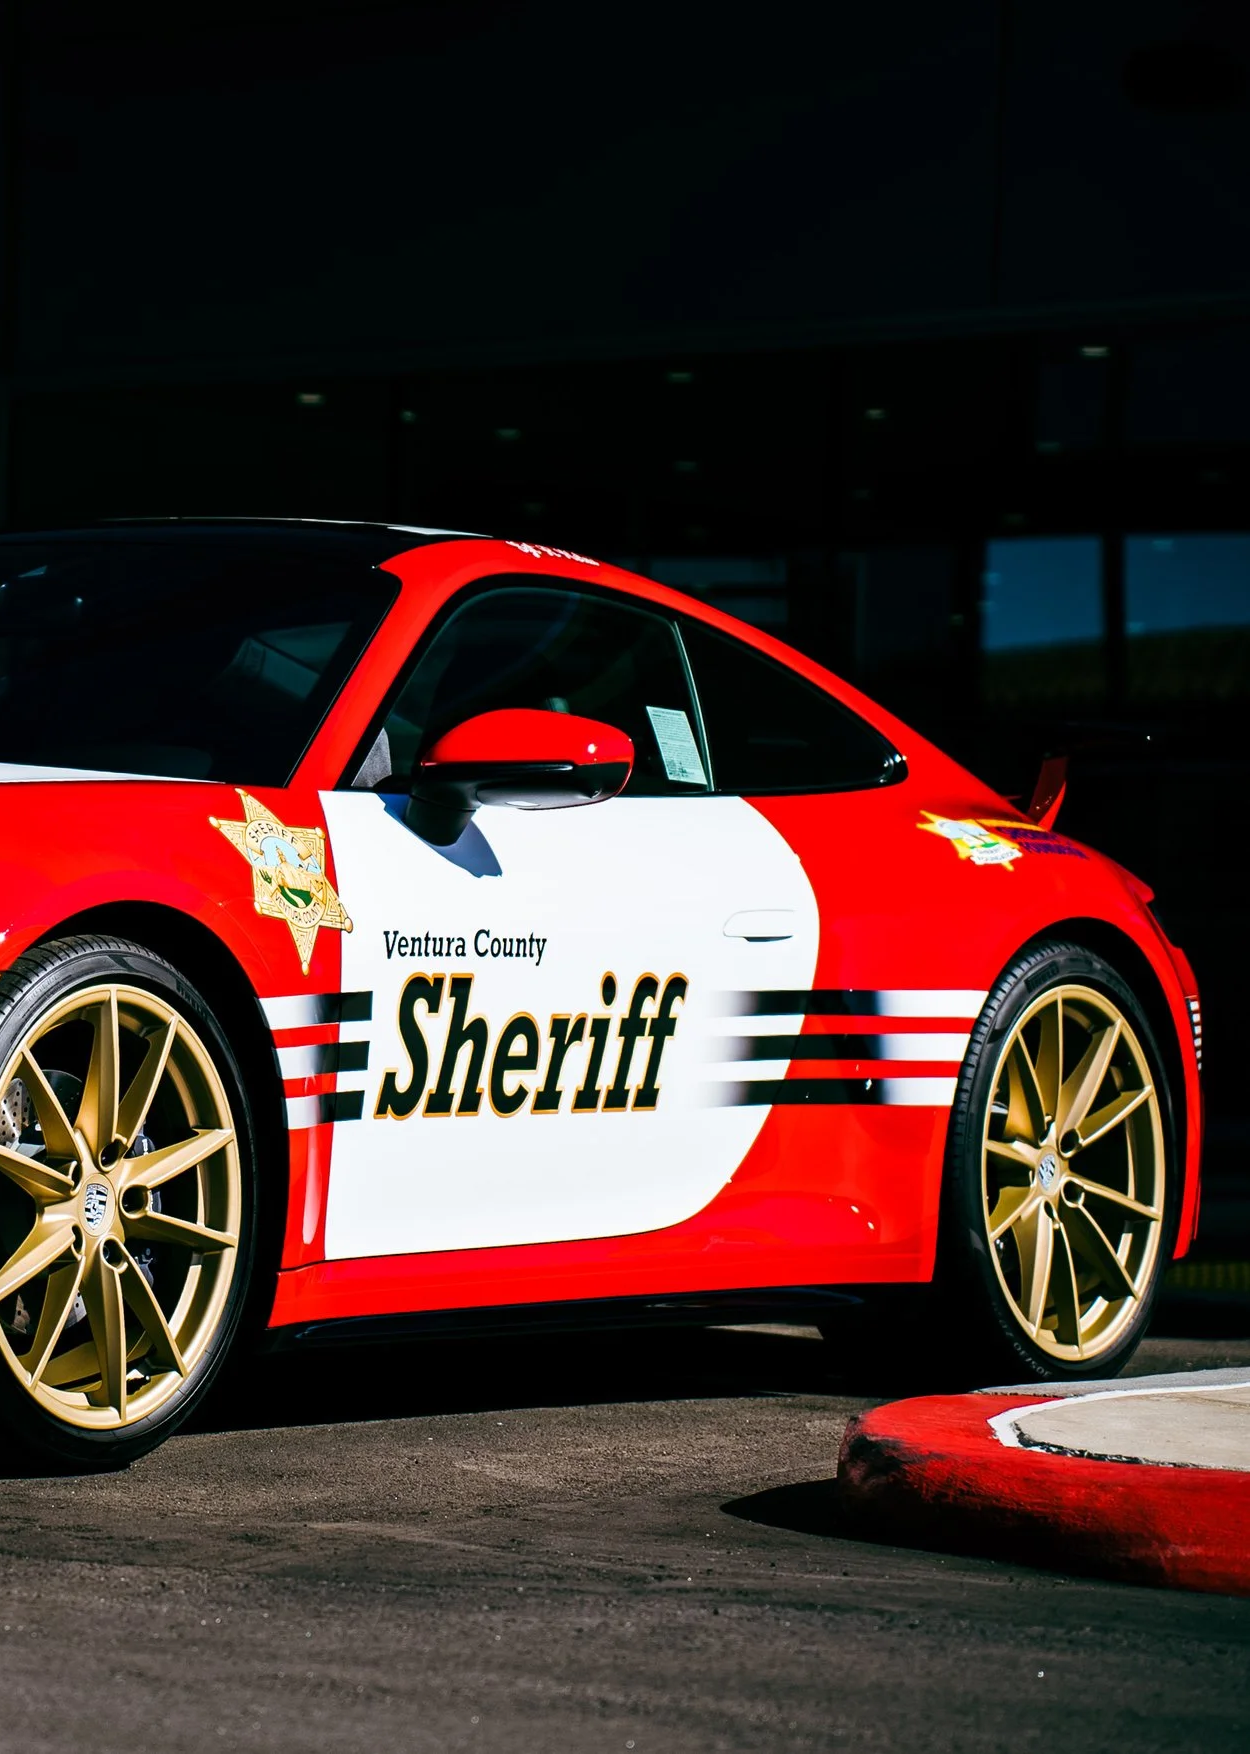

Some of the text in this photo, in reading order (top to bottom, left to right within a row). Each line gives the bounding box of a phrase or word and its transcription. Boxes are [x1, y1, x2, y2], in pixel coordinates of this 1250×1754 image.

[248, 822, 298, 845] SHERIFF
[383, 929, 547, 966] Ventura County
[373, 971, 689, 1121] Sheriff
